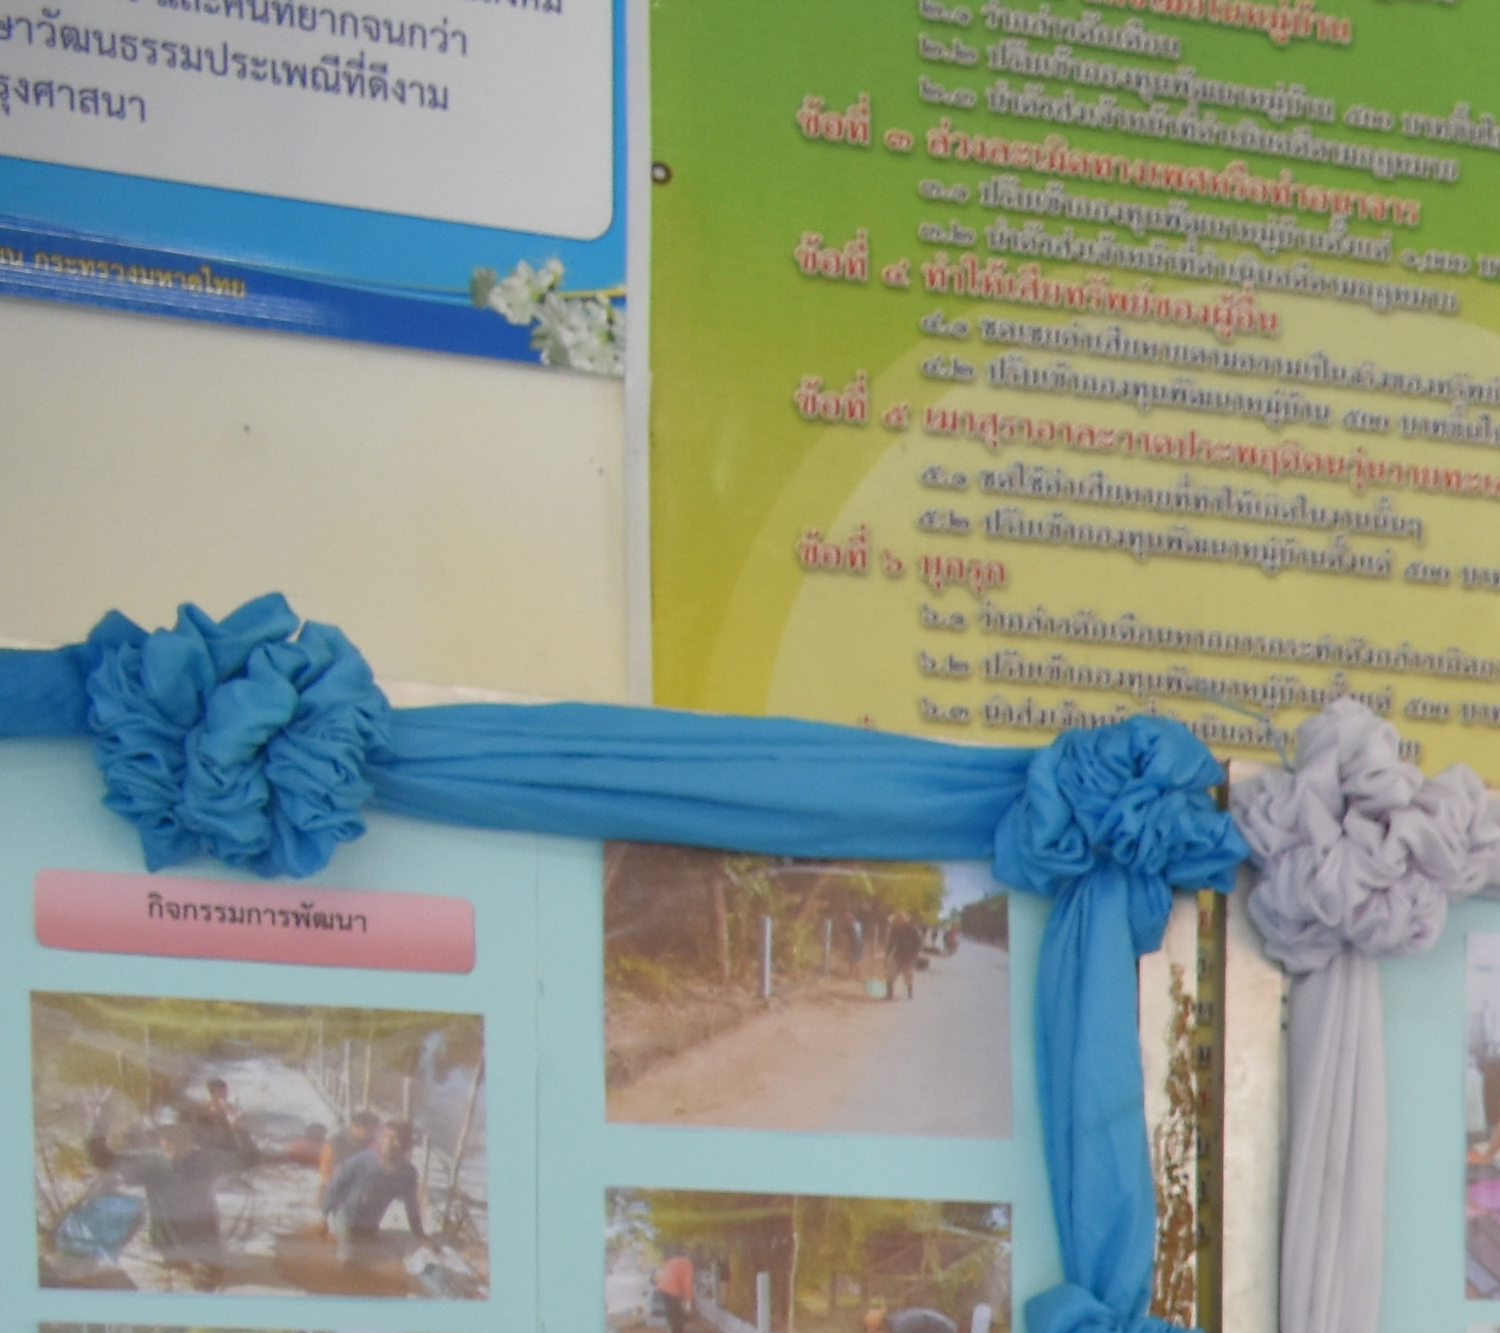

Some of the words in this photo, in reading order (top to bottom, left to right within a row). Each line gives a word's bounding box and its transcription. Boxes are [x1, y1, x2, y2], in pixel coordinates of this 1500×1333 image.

[797, 92, 871, 148] ข้อที่
[34, 250, 247, 299] กระทรวงมหาดไทย
[796, 229, 869, 284] ข้อที่
[795, 368, 869, 423] ข้อที่
[798, 524, 869, 572] ข้อที่
[920, 551, 1009, 595] บุกรุก
[148, 891, 367, 932] กิจกรรมการพัฒนา
